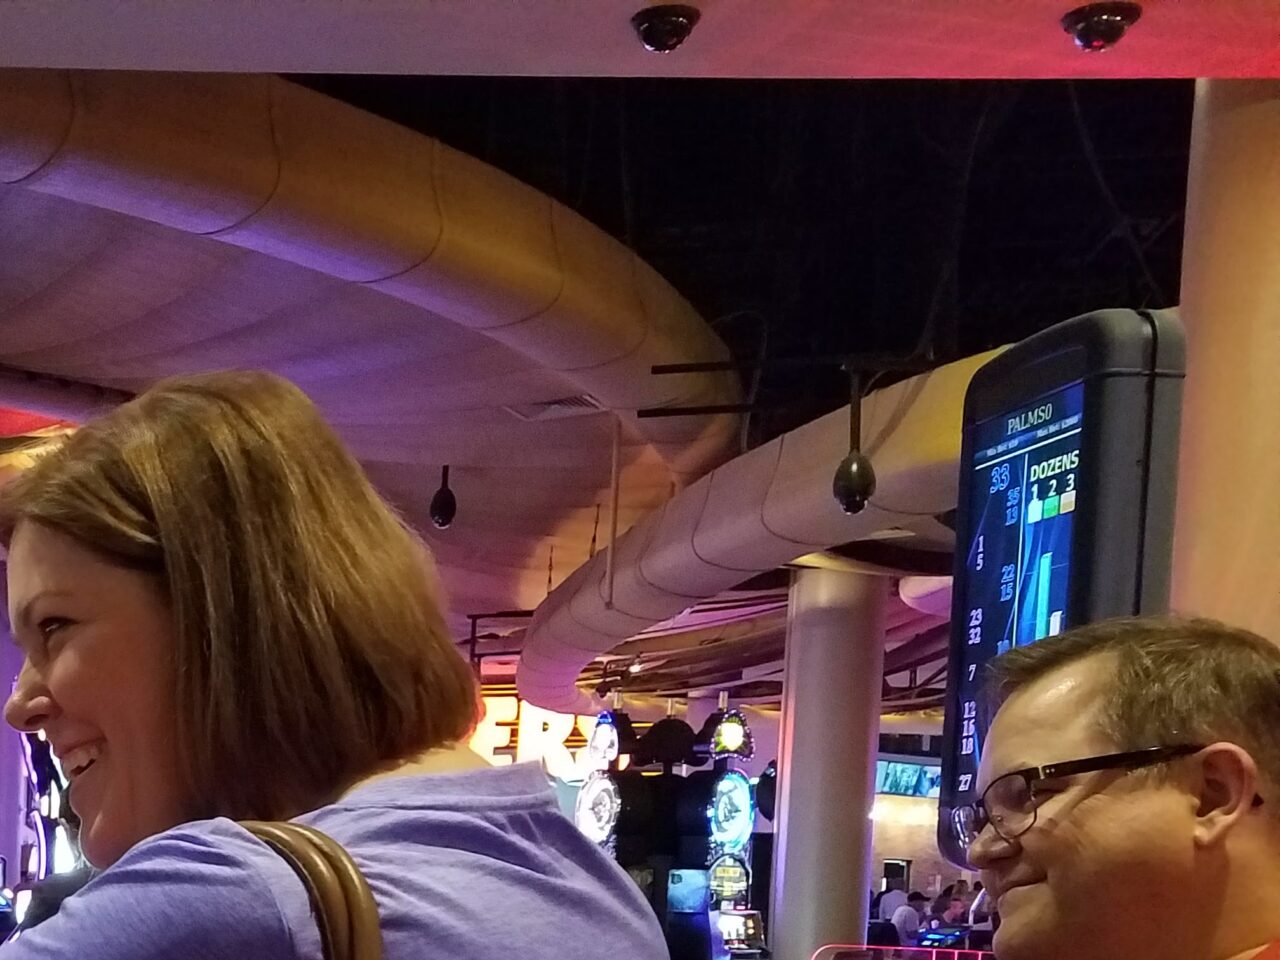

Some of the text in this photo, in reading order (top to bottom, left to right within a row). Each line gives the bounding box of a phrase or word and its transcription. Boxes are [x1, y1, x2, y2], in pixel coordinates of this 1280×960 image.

[1030, 450, 1080, 481] DOZENS
[990, 463, 1010, 494] 33
[1031, 473, 1075, 501] 1 2 3
[977, 535, 984, 553] 1
[975, 553, 984, 571] 5
[1001, 564, 1015, 583] 22
[1000, 582, 1013, 602] 15
[969, 608, 982, 627] 23
[968, 626, 981, 645] 32
[968, 664, 976, 681] 7
[963, 701, 976, 718] 12
[958, 774, 972, 791] 27
